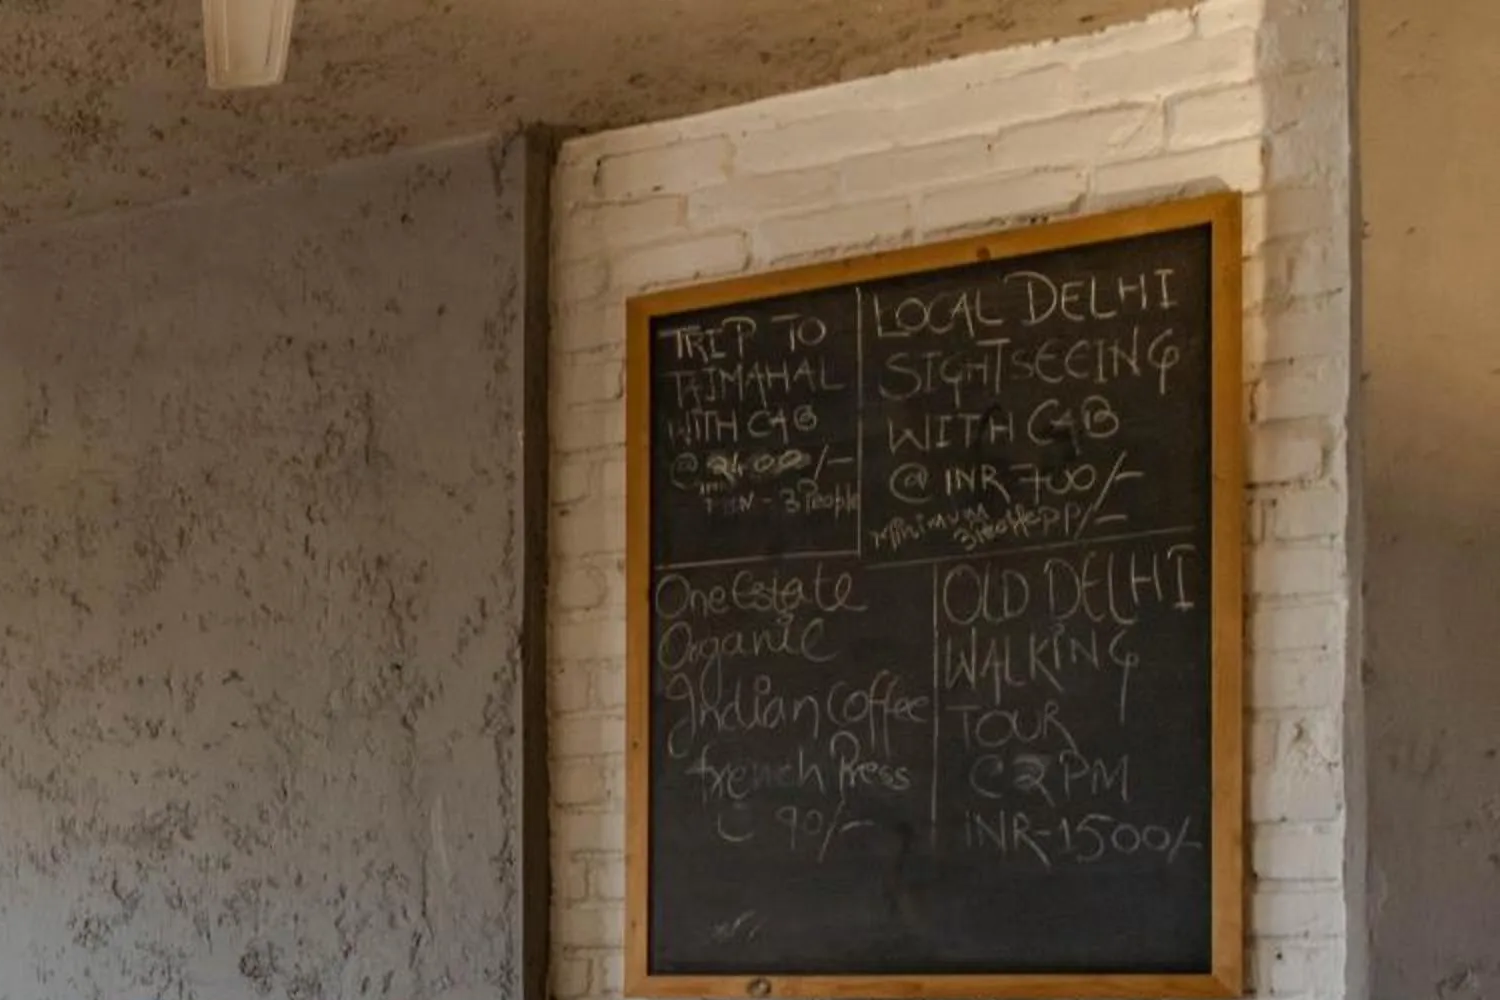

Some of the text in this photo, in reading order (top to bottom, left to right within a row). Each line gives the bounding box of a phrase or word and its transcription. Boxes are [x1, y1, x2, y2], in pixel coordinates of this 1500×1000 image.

[873, 268, 1179, 338] LOCAL DELHI
[658, 314, 827, 363] TRIP TO
[668, 408, 738, 446] WITH
[888, 412, 1014, 456] WITH
[945, 462, 1010, 503] INR
[943, 544, 1196, 625] OLD DELHI
[946, 700, 1078, 750] TOUR
